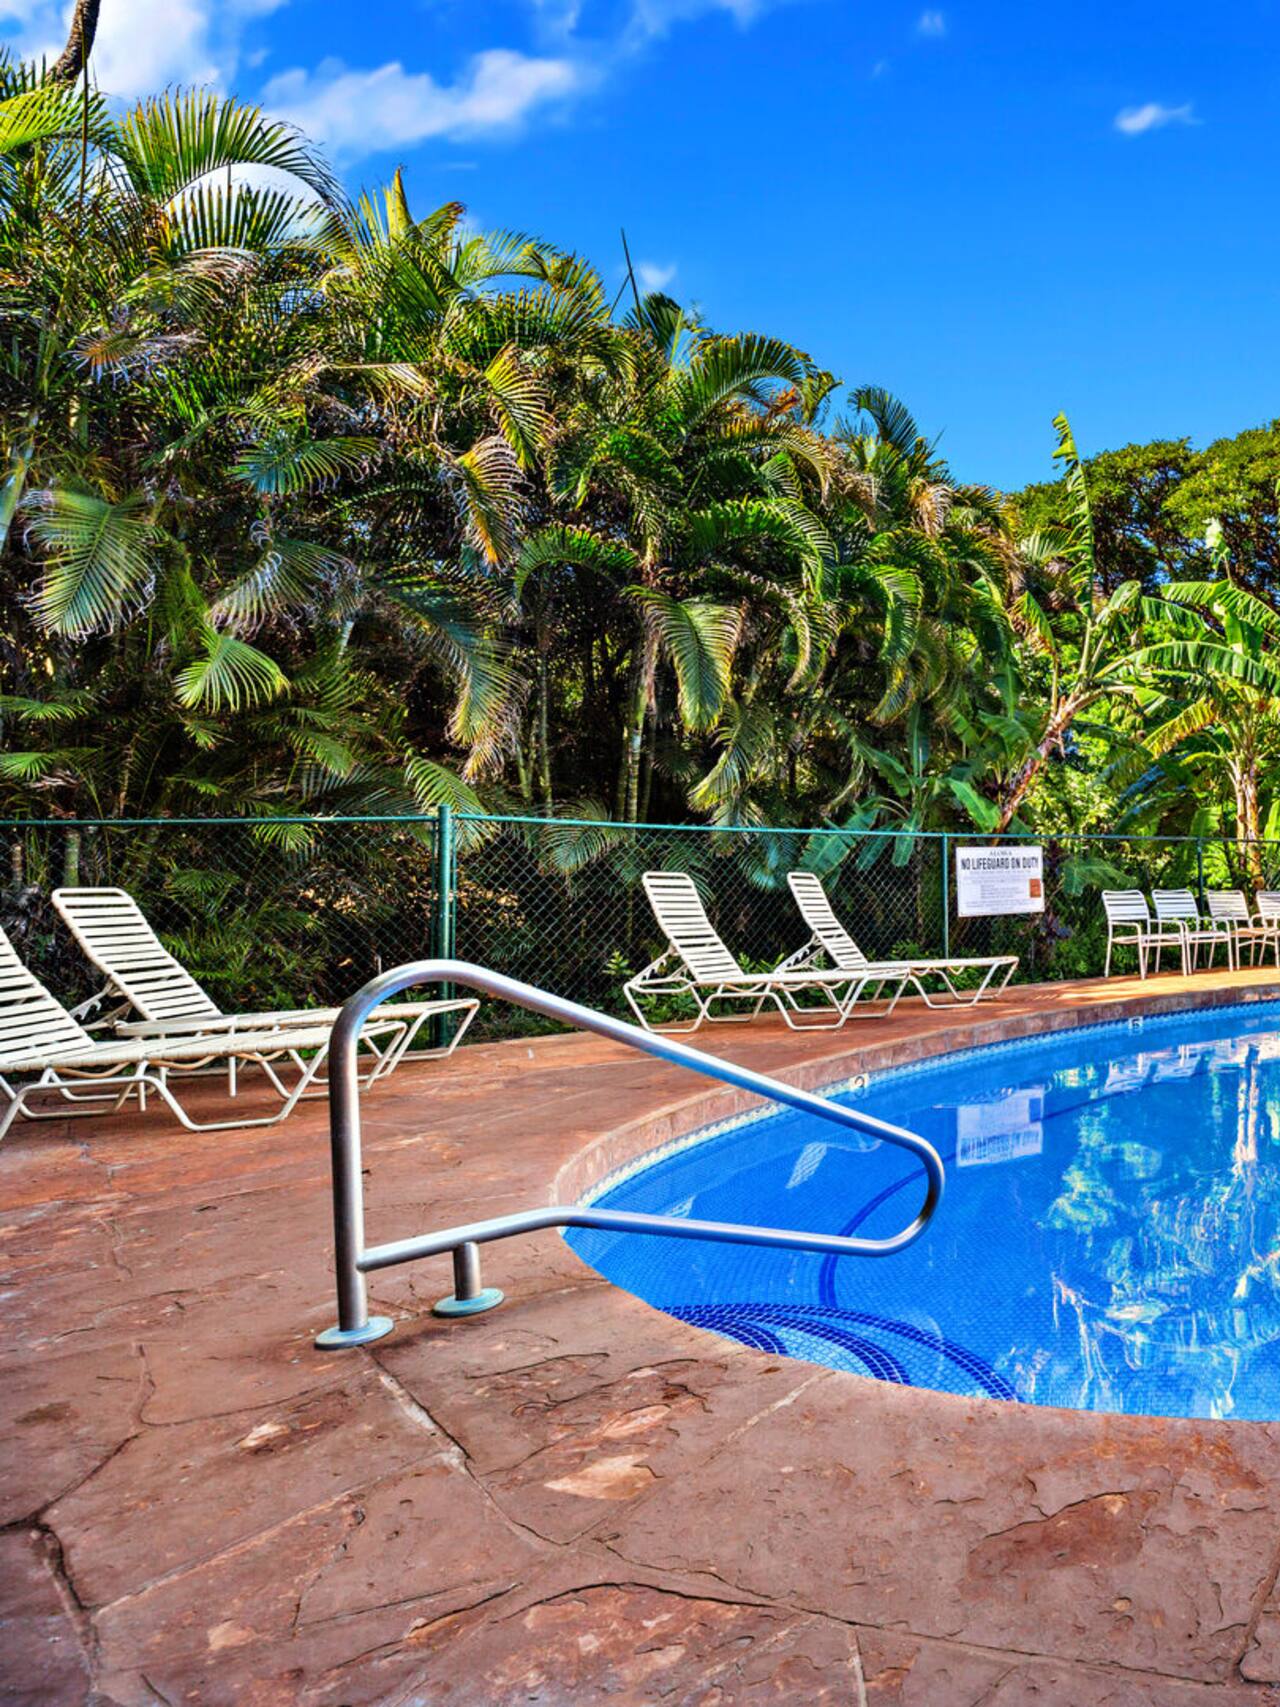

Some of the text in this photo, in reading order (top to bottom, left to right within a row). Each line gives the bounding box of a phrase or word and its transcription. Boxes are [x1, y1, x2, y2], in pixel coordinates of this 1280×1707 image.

[961, 856, 1039, 870] NO LIFEGUARD ON DUTY
